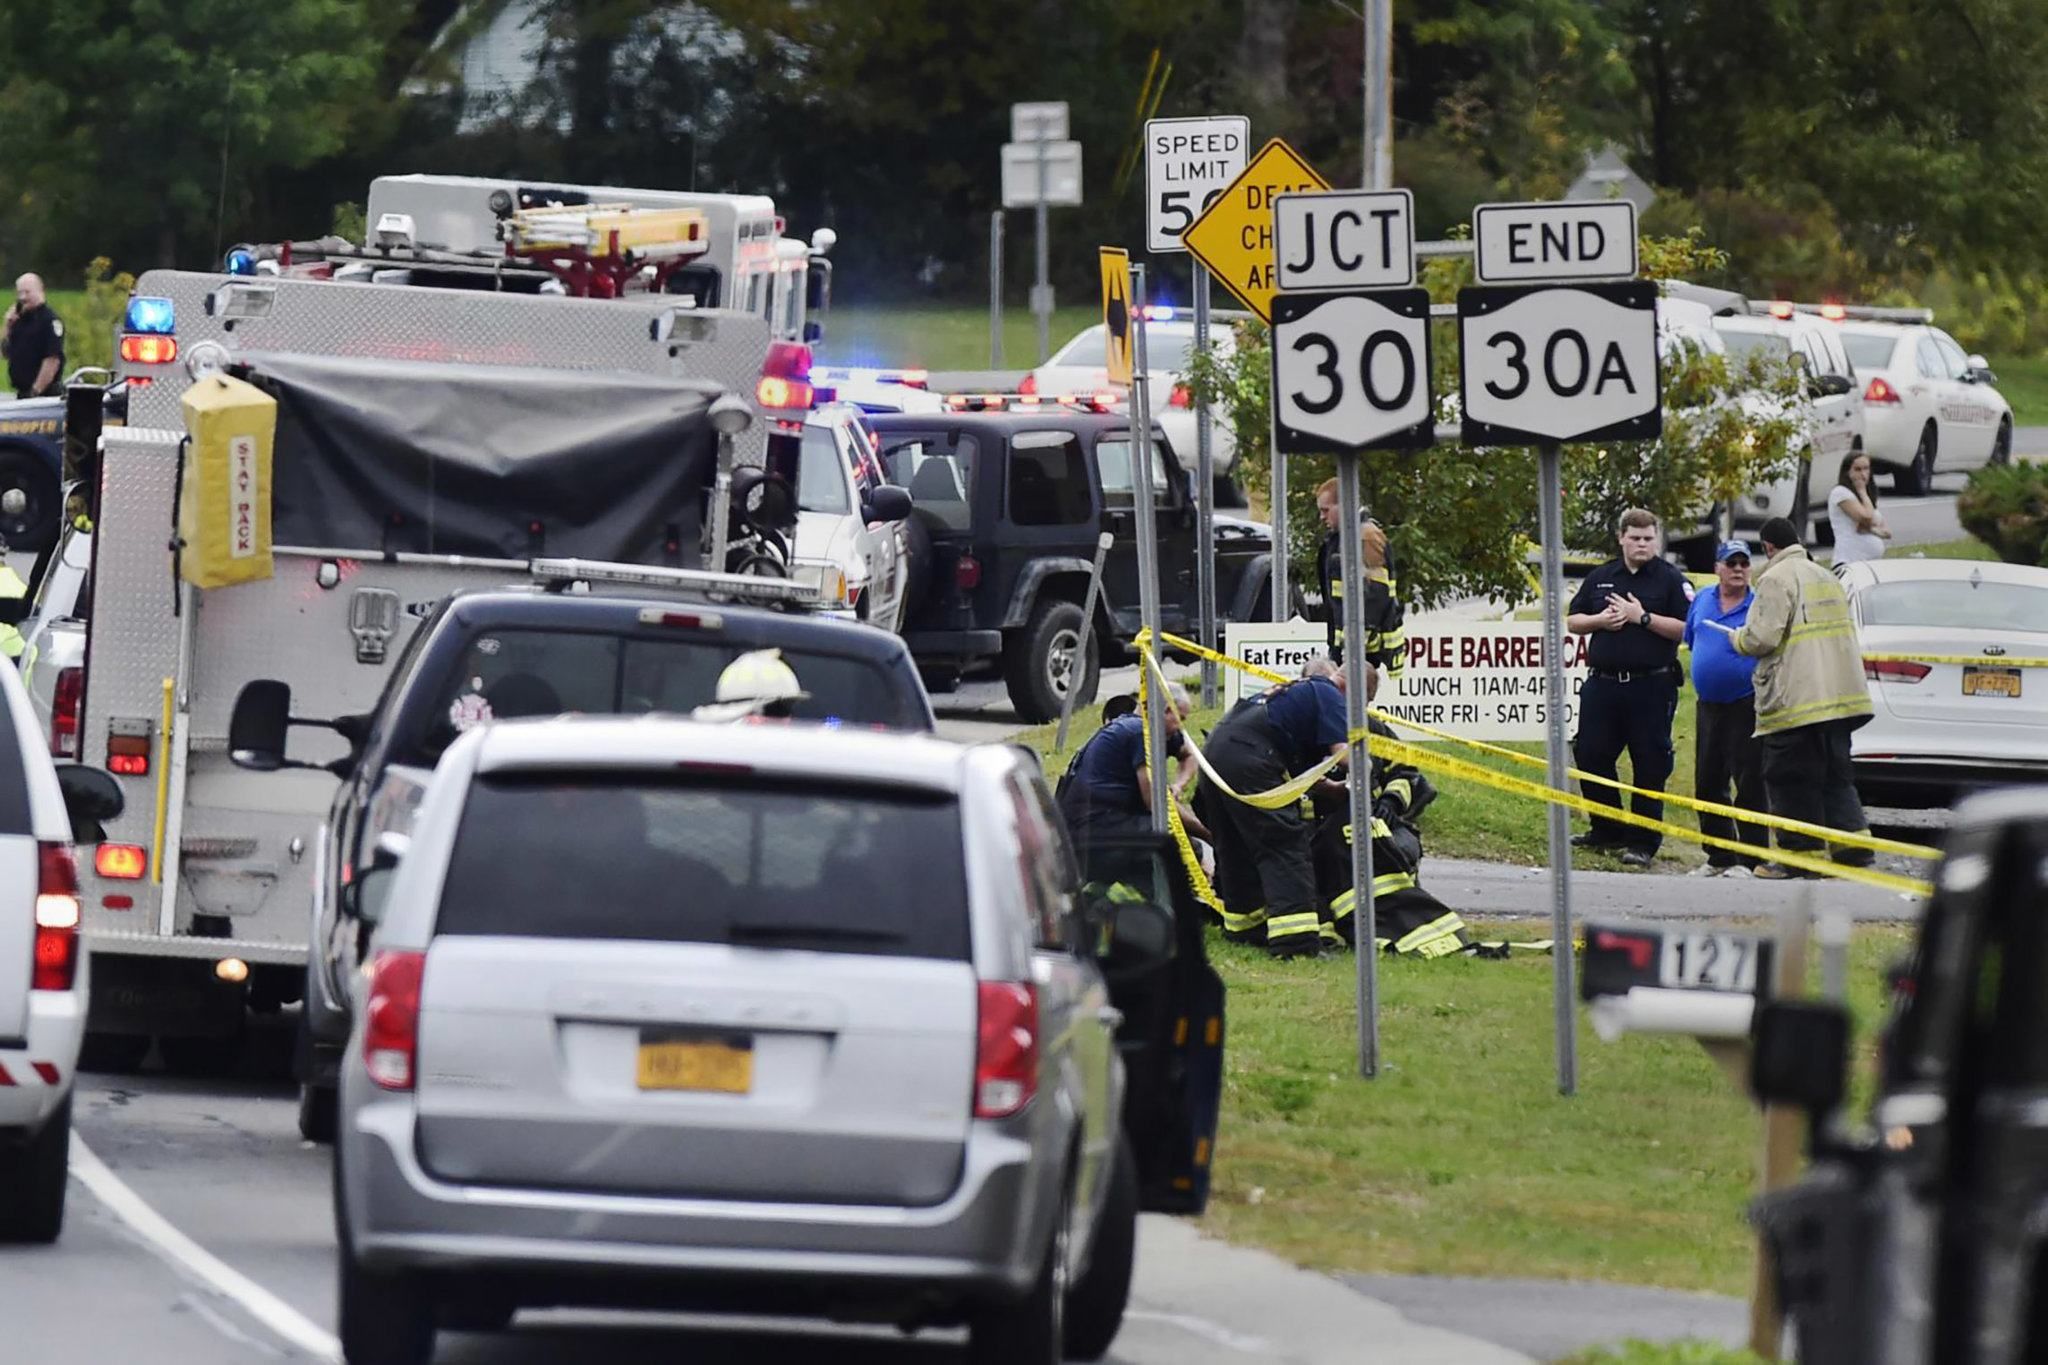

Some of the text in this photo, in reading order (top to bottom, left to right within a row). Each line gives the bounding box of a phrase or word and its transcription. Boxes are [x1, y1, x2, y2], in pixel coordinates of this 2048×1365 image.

[1157, 133, 1239, 155] SPEED
[1165, 160, 1230, 181] LIMIT
[1247, 184, 1311, 210] DE
[1241, 224, 1274, 251] CH
[1286, 209, 1400, 274] JCT
[1508, 221, 1605, 264] END
[1291, 329, 1416, 415] 30
[1484, 328, 1637, 400] 30A
[1244, 649, 1270, 665] Eat
[1403, 636, 1453, 669] PLE
[1562, 635, 1588, 669] CA
[1399, 676, 1461, 696] LUNCH
[1472, 676, 1567, 696] 11AM-4P
[1451, 704, 1478, 723] FRI
[1496, 703, 1529, 724] SAT
[1674, 935, 1749, 985] 127
